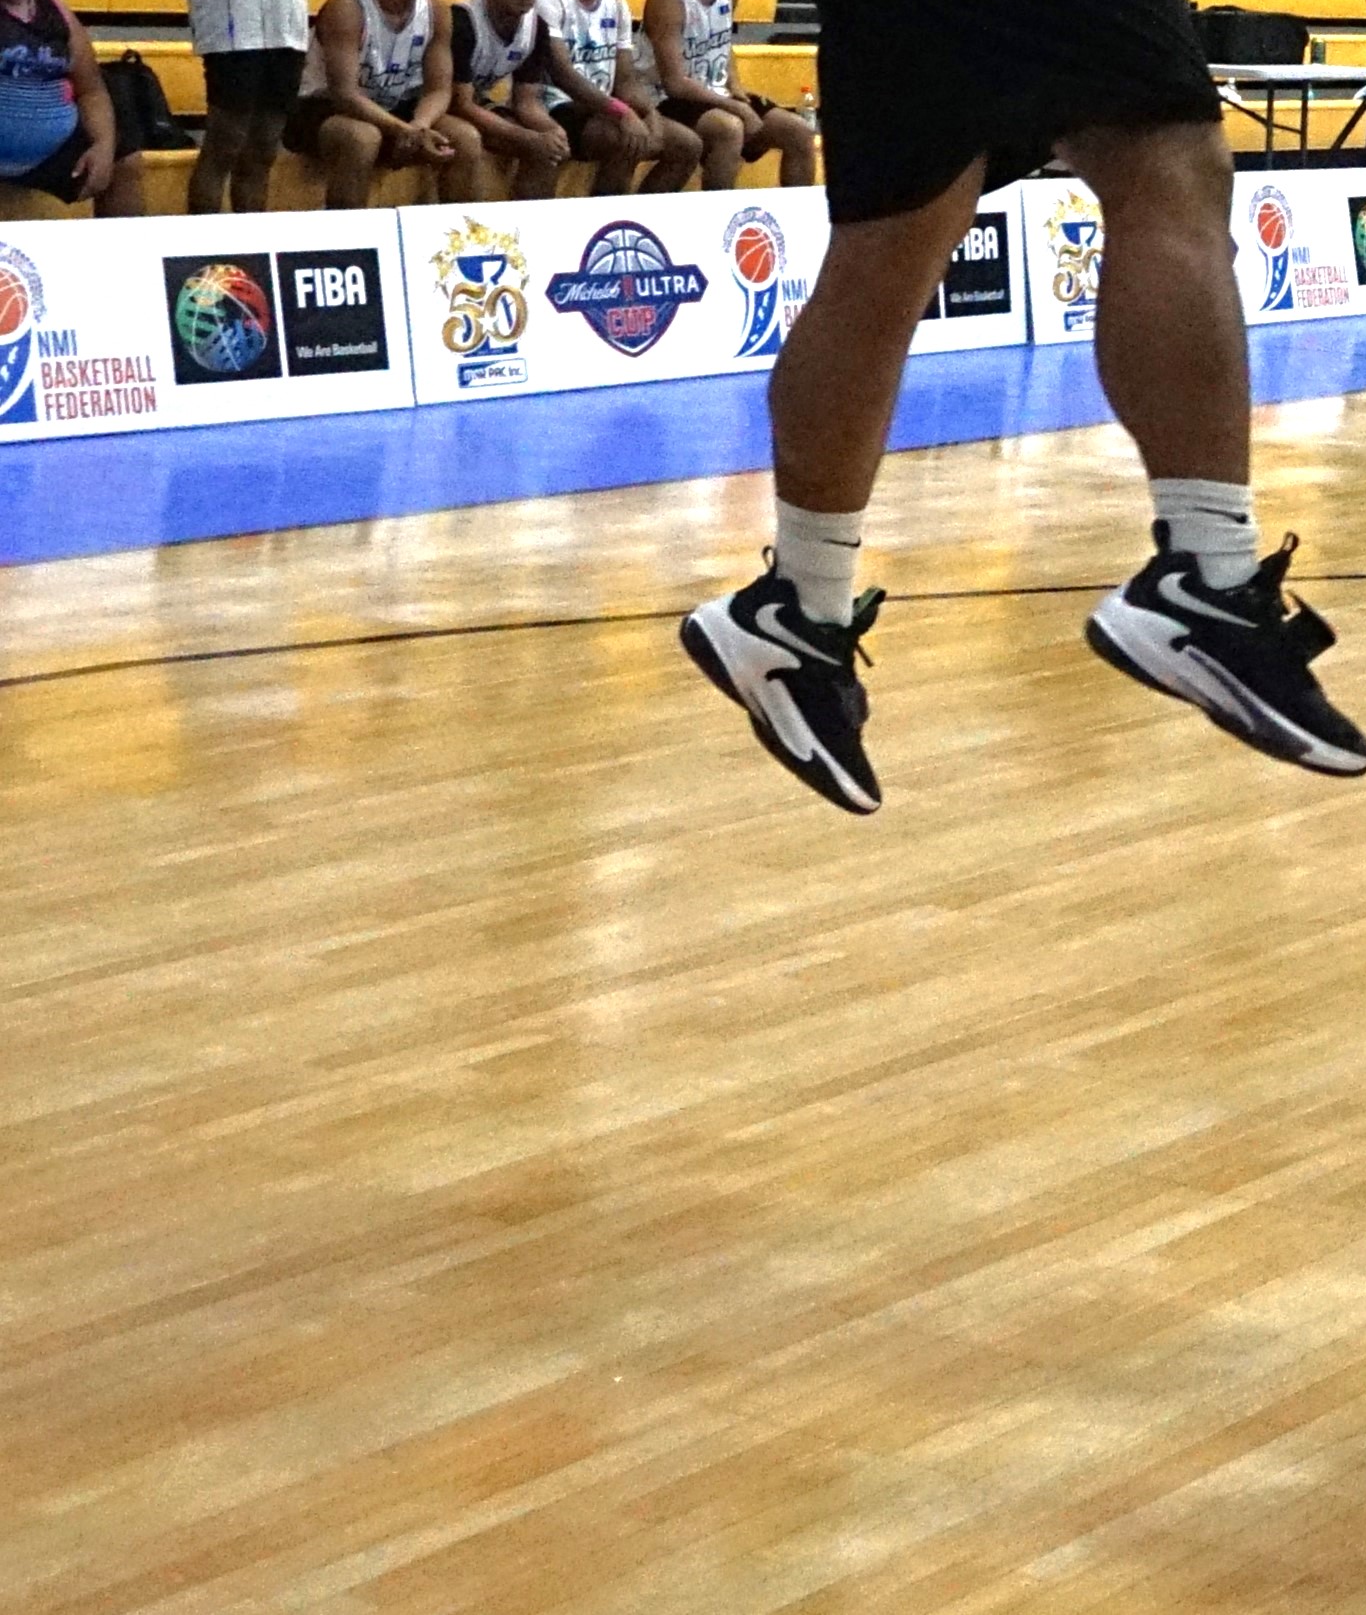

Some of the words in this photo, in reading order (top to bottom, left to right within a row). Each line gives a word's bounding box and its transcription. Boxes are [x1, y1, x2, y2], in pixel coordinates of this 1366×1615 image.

[1292, 247, 1311, 264] NMI
[294, 265, 367, 308] FIBA
[554, 280, 620, 304] Michelob
[636, 275, 699, 296] ULTRA
[782, 278, 808, 301] NMI
[1294, 266, 1348, 287] BASKETBALL
[1297, 287, 1350, 308] FEDERATION
[442, 281, 529, 354] 50
[608, 306, 656, 337] CUP
[37, 329, 77, 358] NMI
[41, 355, 156, 390] BASKETBALL
[44, 386, 156, 421] FEDERATION
